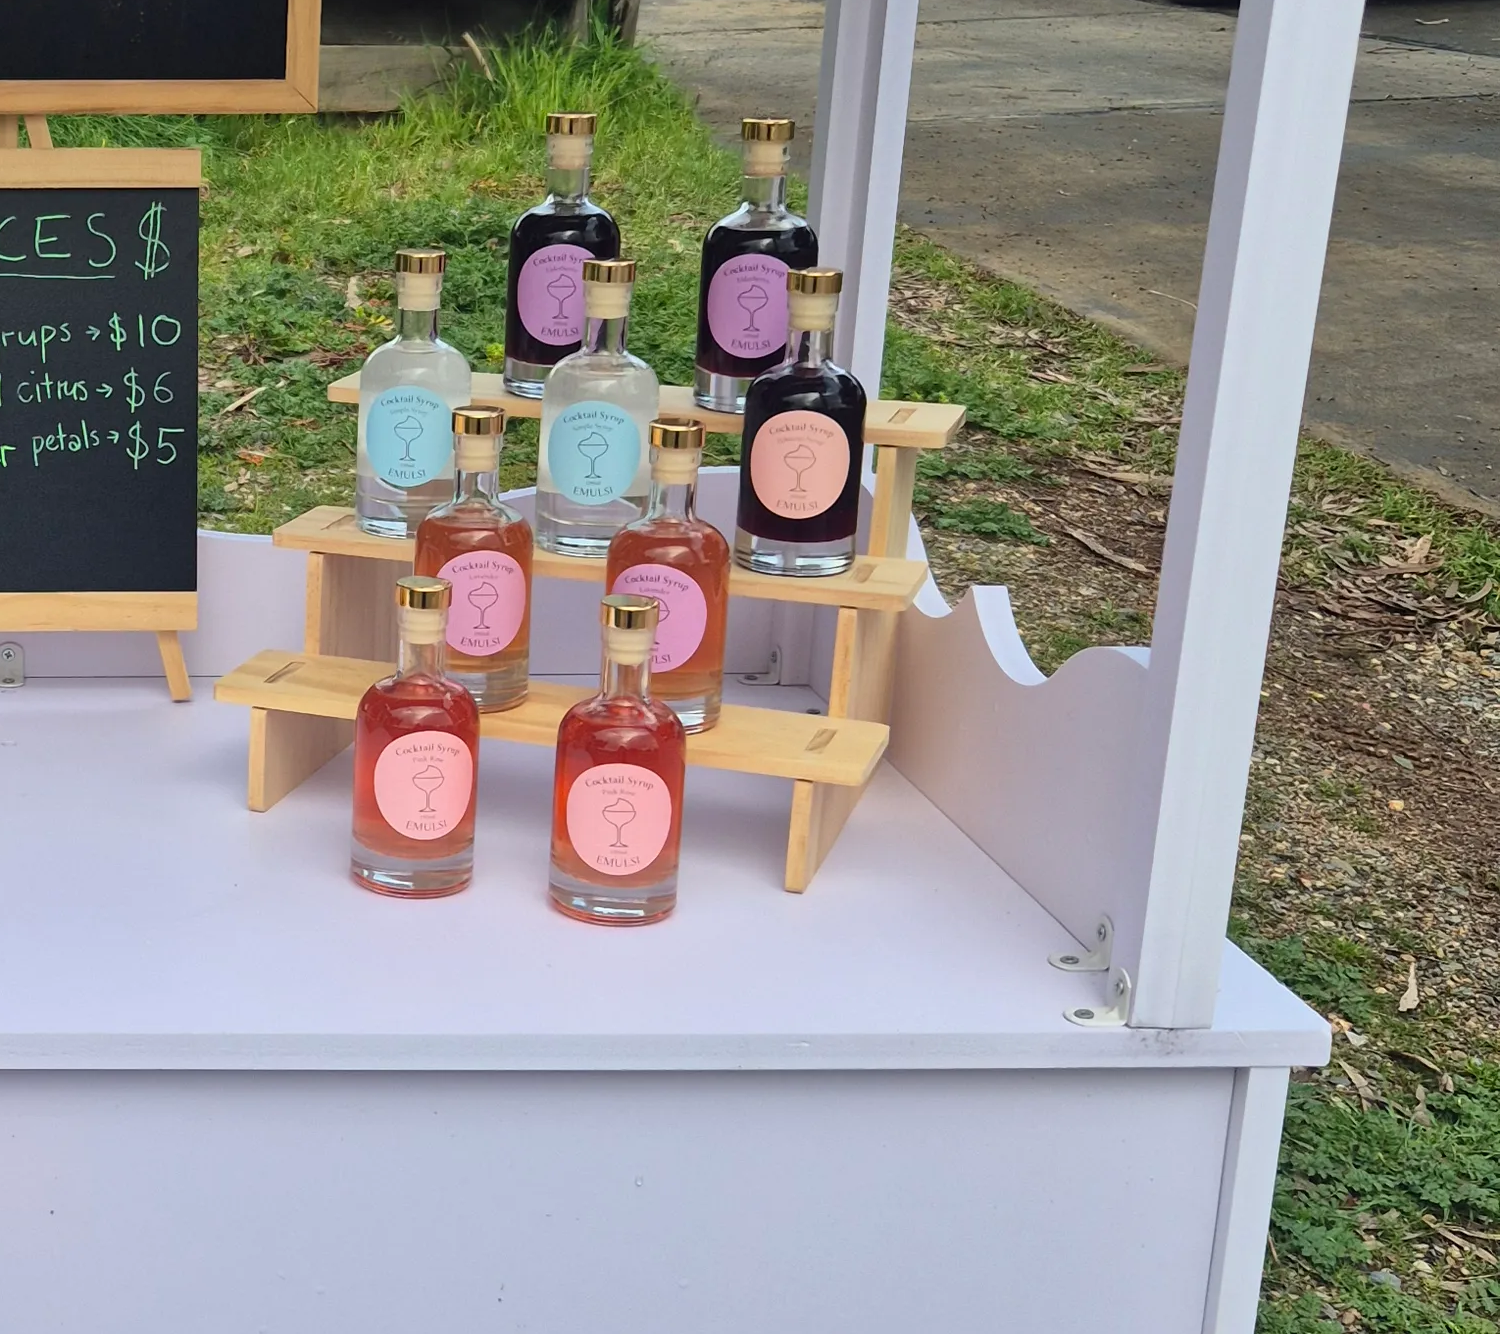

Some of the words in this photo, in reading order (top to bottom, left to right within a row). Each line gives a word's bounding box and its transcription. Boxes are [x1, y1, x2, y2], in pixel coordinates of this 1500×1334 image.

[108, 311, 182, 351] $10
[122, 367, 175, 413] $6
[31, 420, 101, 466] petals
[125, 420, 185, 470] $5
[573, 486, 614, 498] EMULSI
